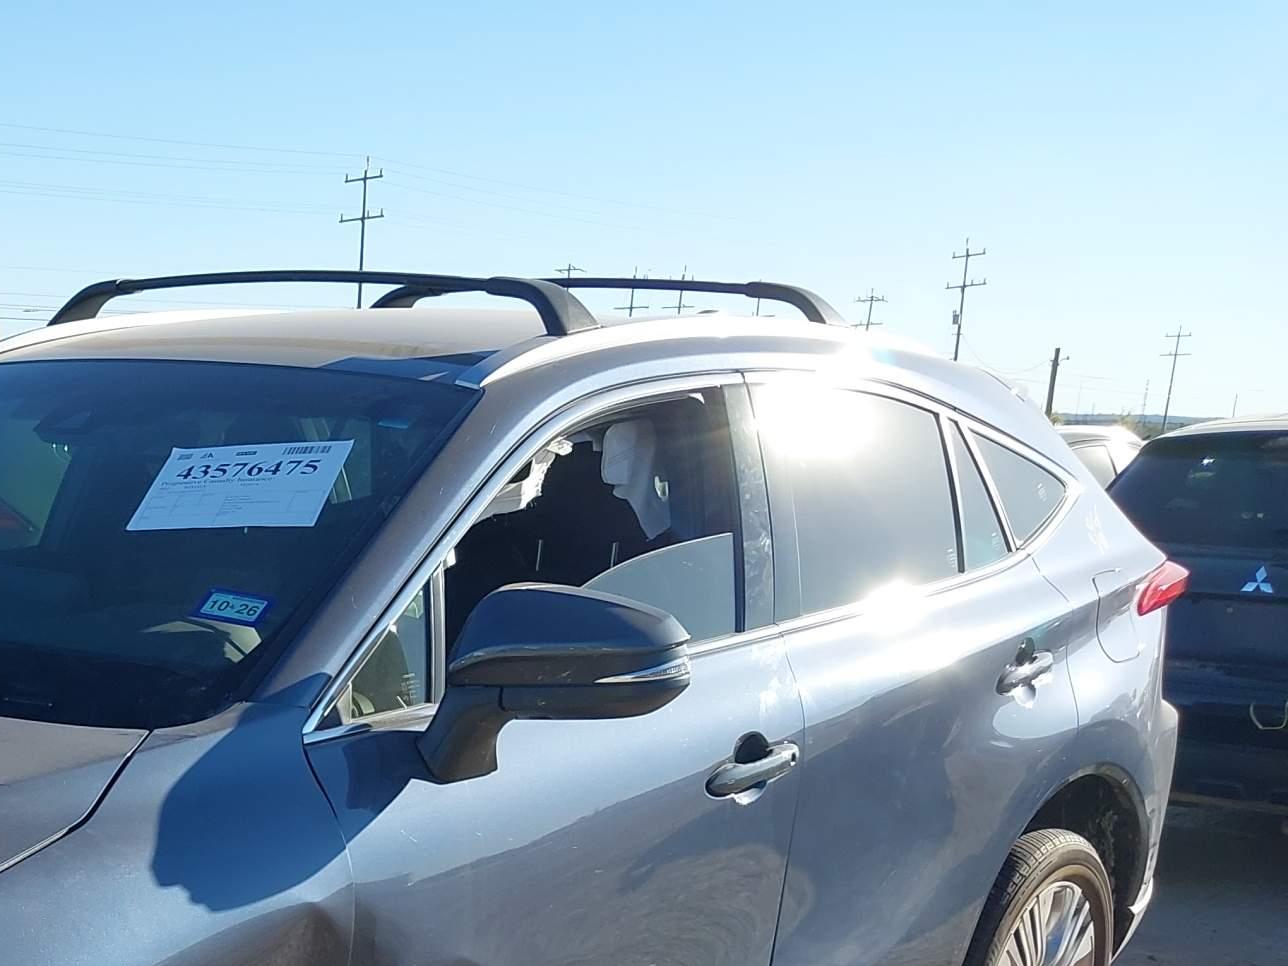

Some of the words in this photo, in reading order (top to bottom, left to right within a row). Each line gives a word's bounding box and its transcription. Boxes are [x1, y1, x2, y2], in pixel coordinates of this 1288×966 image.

[176, 459, 321, 480] 43576475
[208, 600, 230, 612] 10
[234, 603, 260, 617] 26
